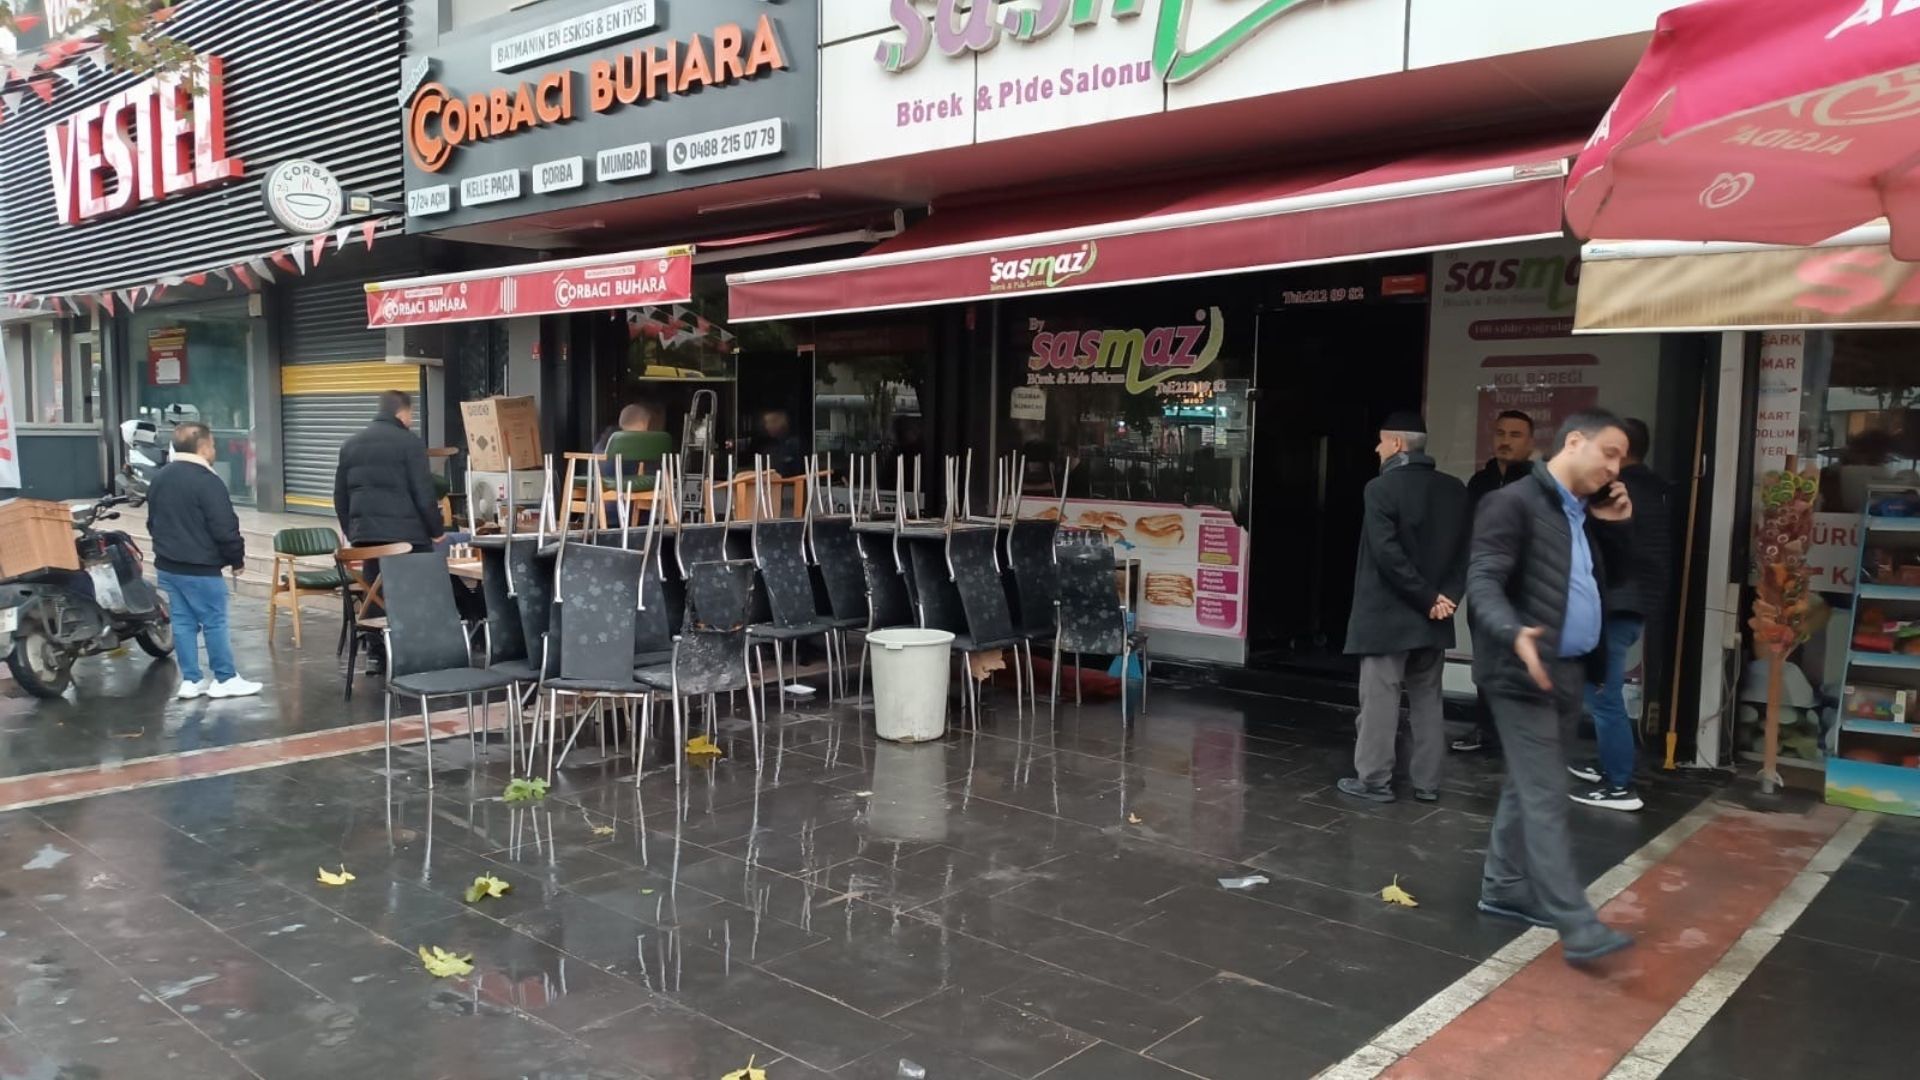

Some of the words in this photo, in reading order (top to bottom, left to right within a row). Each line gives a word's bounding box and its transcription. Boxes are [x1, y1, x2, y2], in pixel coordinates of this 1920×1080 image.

[548, 29, 561, 49] EN
[597, 17, 604, 34] &
[606, 11, 620, 32] EN
[590, 14, 785, 112] BUHARA
[896, 92, 964, 127] Börek
[977, 84, 993, 111] &
[999, 76, 1054, 109] Pide
[1059, 58, 1153, 97] Salonu
[45, 54, 242, 224] VESTEL
[690, 139, 718, 160] 0488
[721, 133, 741, 154] 215
[744, 130, 757, 150] 07
[760, 126, 775, 146] 79
[542, 164, 573, 188] ÇORBA
[601, 150, 647, 175] MUMBAR
[466, 178, 490, 199] KELLE
[491, 173, 514, 197] PAÇA
[615, 276, 667, 295] BUHARA
[428, 296, 467, 313] BUHARA
[1028, 324, 1206, 396] sasmaz
[1759, 411, 1791, 420] KART
